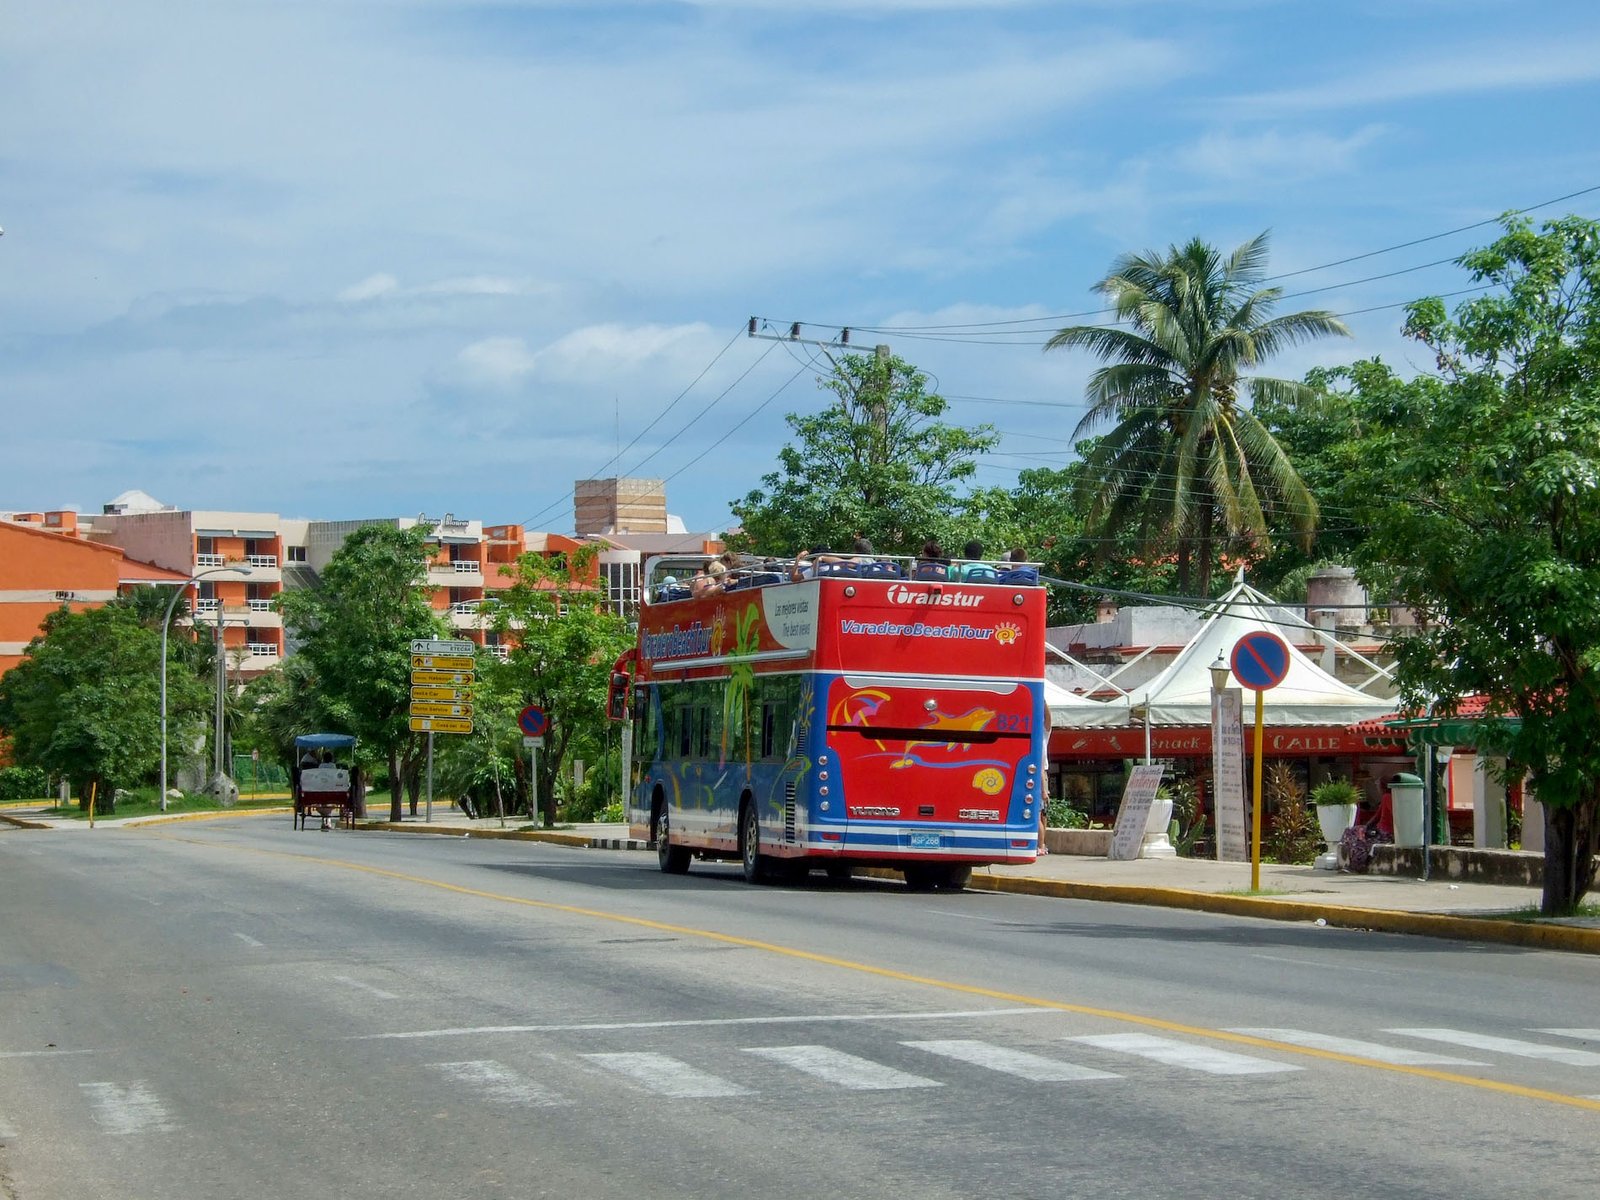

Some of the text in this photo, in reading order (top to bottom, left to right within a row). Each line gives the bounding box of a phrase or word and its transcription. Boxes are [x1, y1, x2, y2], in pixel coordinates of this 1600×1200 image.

[782, 600, 797, 619] mejores
[797, 599, 809, 614] vistas
[998, 713, 1030, 731] 821
[850, 806, 901, 816] YUTONG
